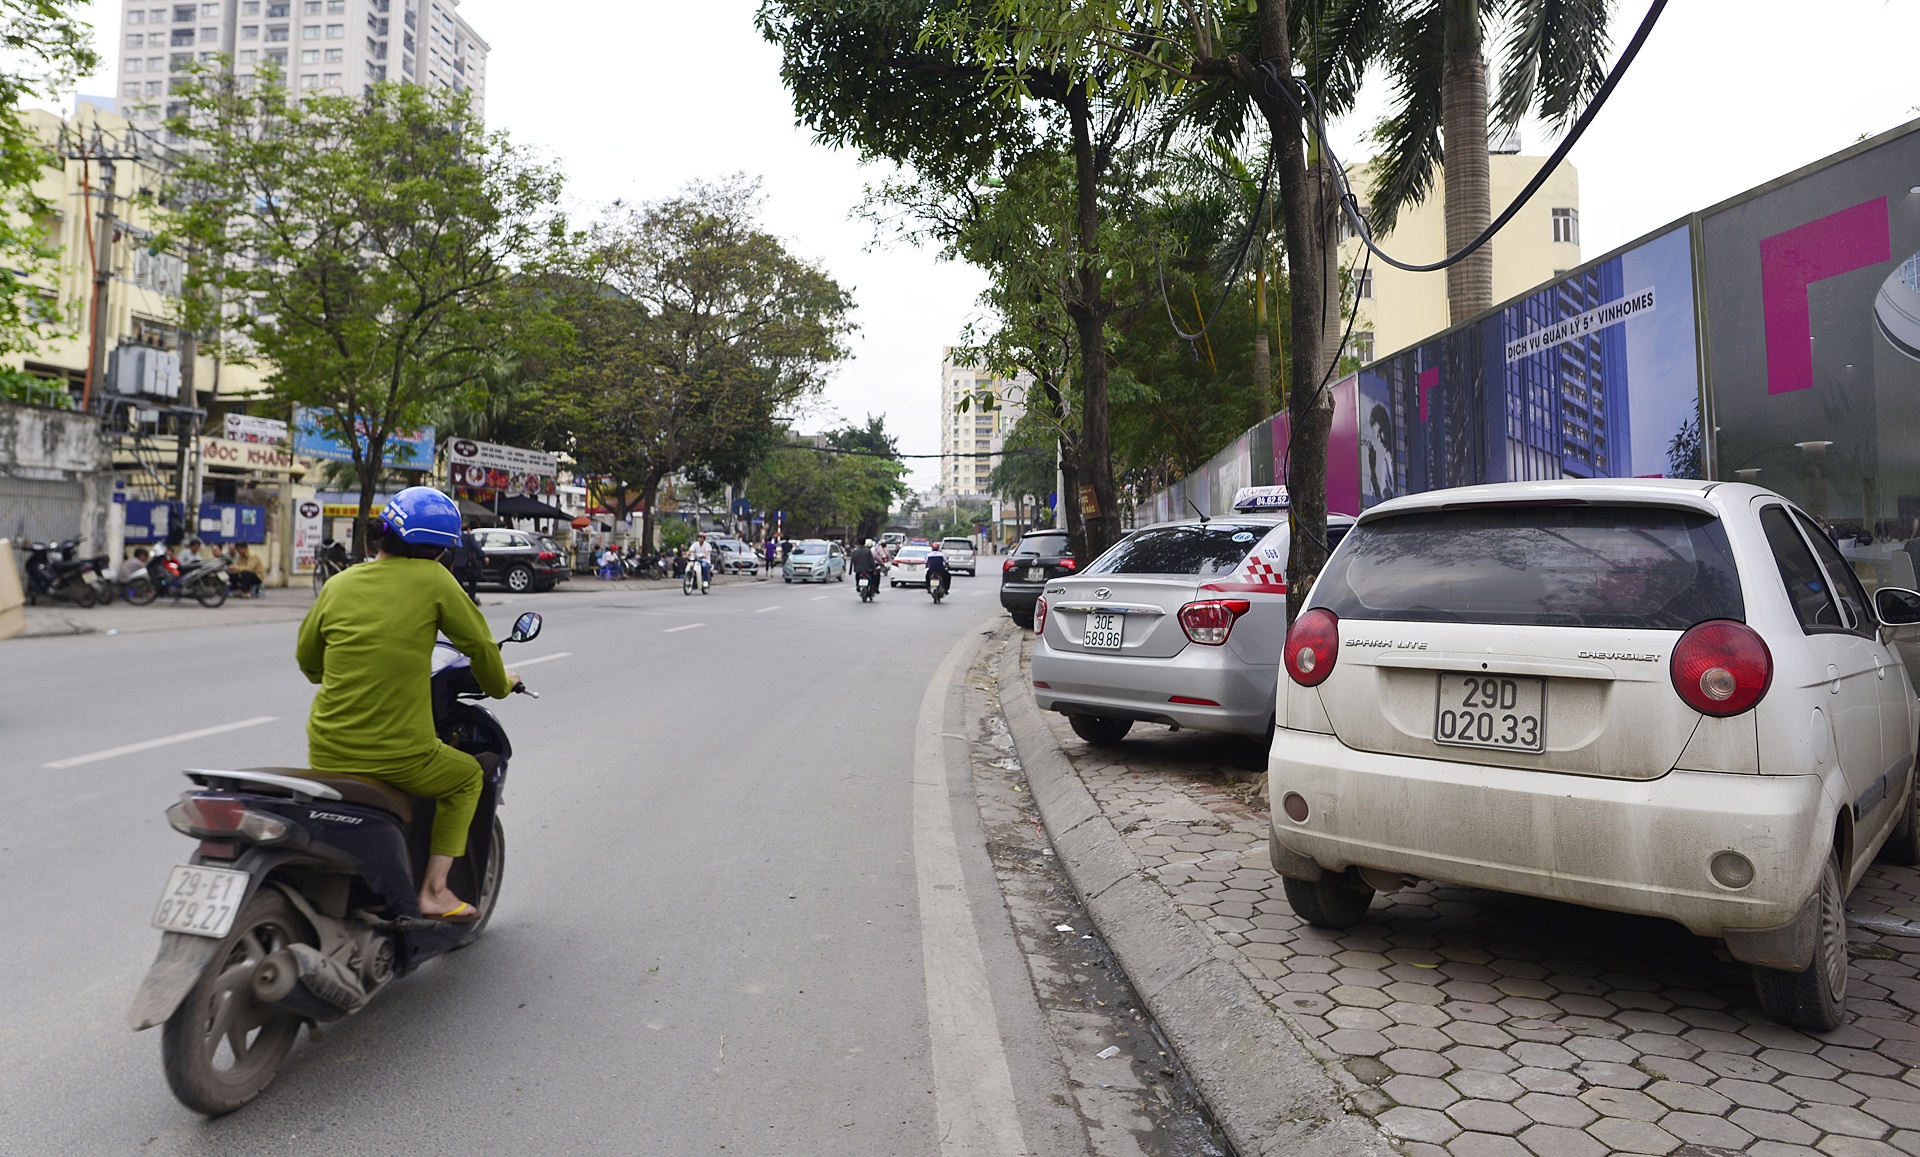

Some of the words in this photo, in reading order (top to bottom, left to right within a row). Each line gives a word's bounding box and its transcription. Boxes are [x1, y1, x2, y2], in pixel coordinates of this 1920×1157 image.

[1508, 340, 1527, 360] DỊCH
[1529, 336, 1540, 352] VỤ
[1542, 323, 1568, 344] QUẢN
[1570, 316, 1580, 336] LÝ
[1597, 292, 1654, 324] VINHOMES
[1256, 496, 1290, 506] 04.62.52.
[1094, 615, 1115, 630] 30E
[1085, 631, 1120, 647] 589.86
[1345, 638, 1393, 648] SPARK
[1397, 640, 1428, 650] LITE
[1577, 650, 1662, 662] CHEVROLET
[1462, 677, 1518, 710] 29D
[1440, 709, 1539, 746] 020.33
[174, 871, 235, 901] 29-E1
[158, 898, 231, 931] 879.27
